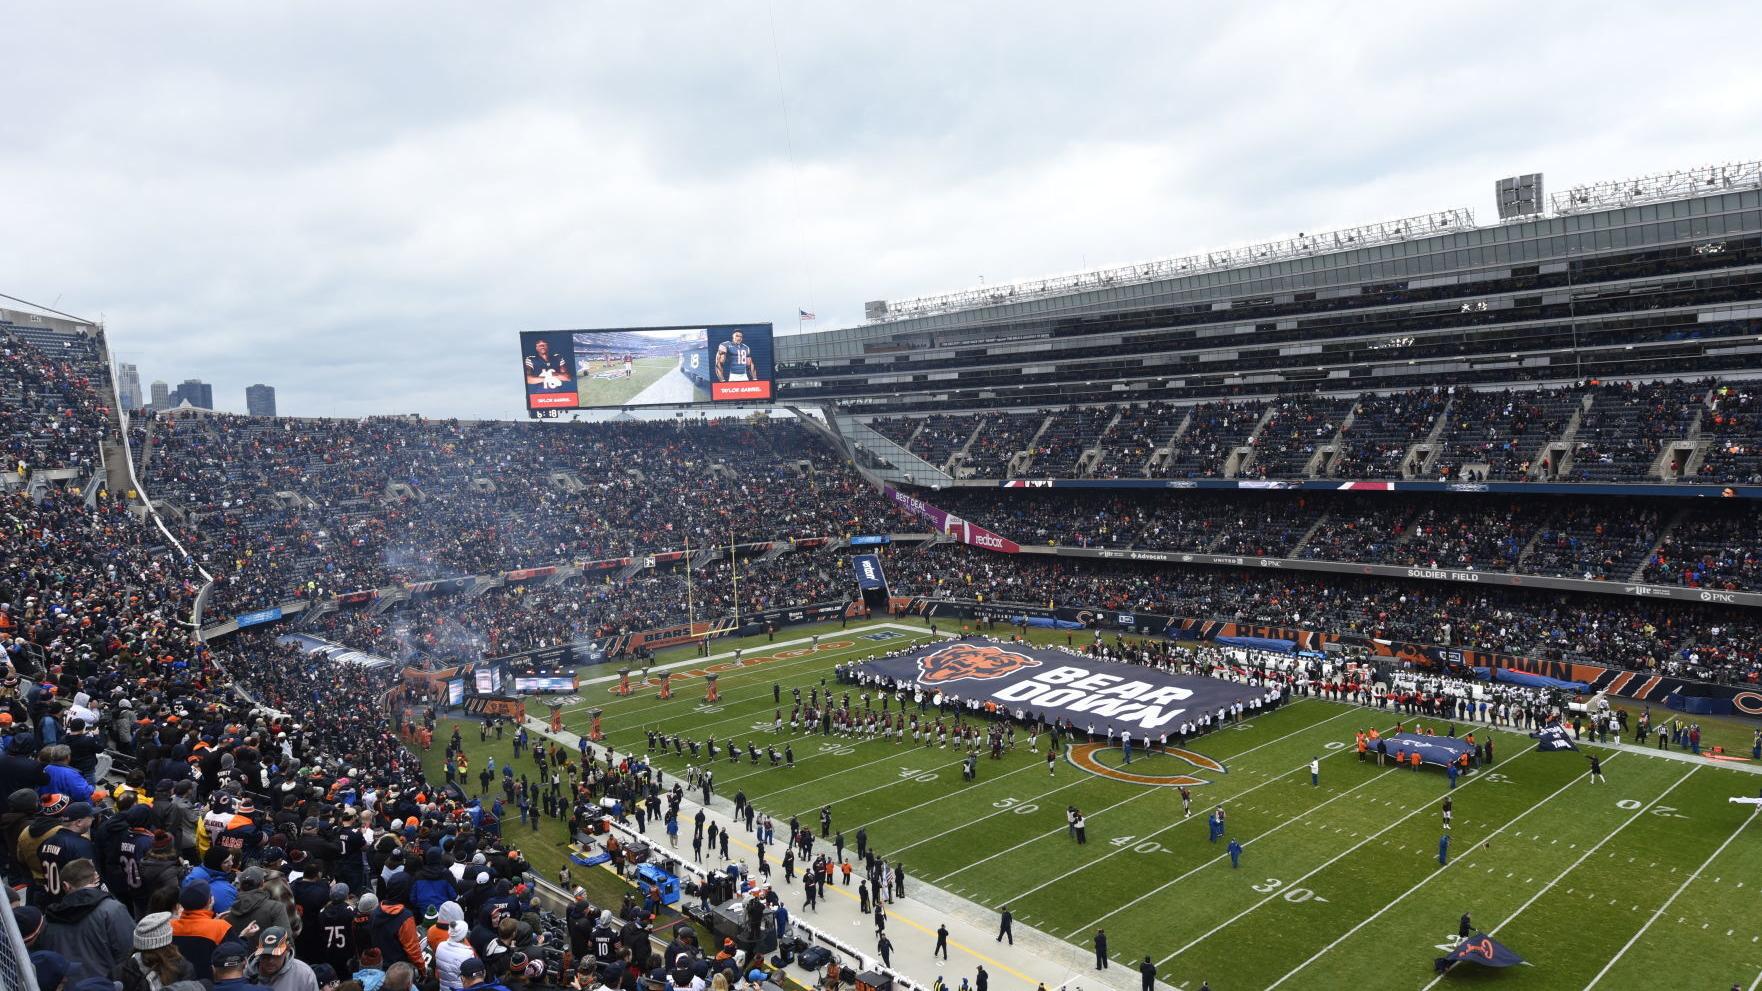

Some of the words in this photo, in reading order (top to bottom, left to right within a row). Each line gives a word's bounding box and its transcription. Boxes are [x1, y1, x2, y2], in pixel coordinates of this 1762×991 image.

[896, 492, 909, 504] BEST
[911, 499, 925, 512] DEAL
[975, 533, 1003, 548] redbox
[1407, 569, 1447, 579] SOLDIER
[1452, 572, 1479, 581] FIELD
[1713, 594, 1735, 602] PNC
[1033, 665, 1194, 704] BEAR
[991, 679, 1186, 729] DOWN
[898, 766, 939, 783] 40
[992, 797, 1039, 816] 50
[1108, 834, 1162, 854] 40
[42, 860, 60, 895] 30
[1251, 877, 1314, 903] 30
[324, 925, 346, 948] 75
[598, 942, 608, 957] 10
